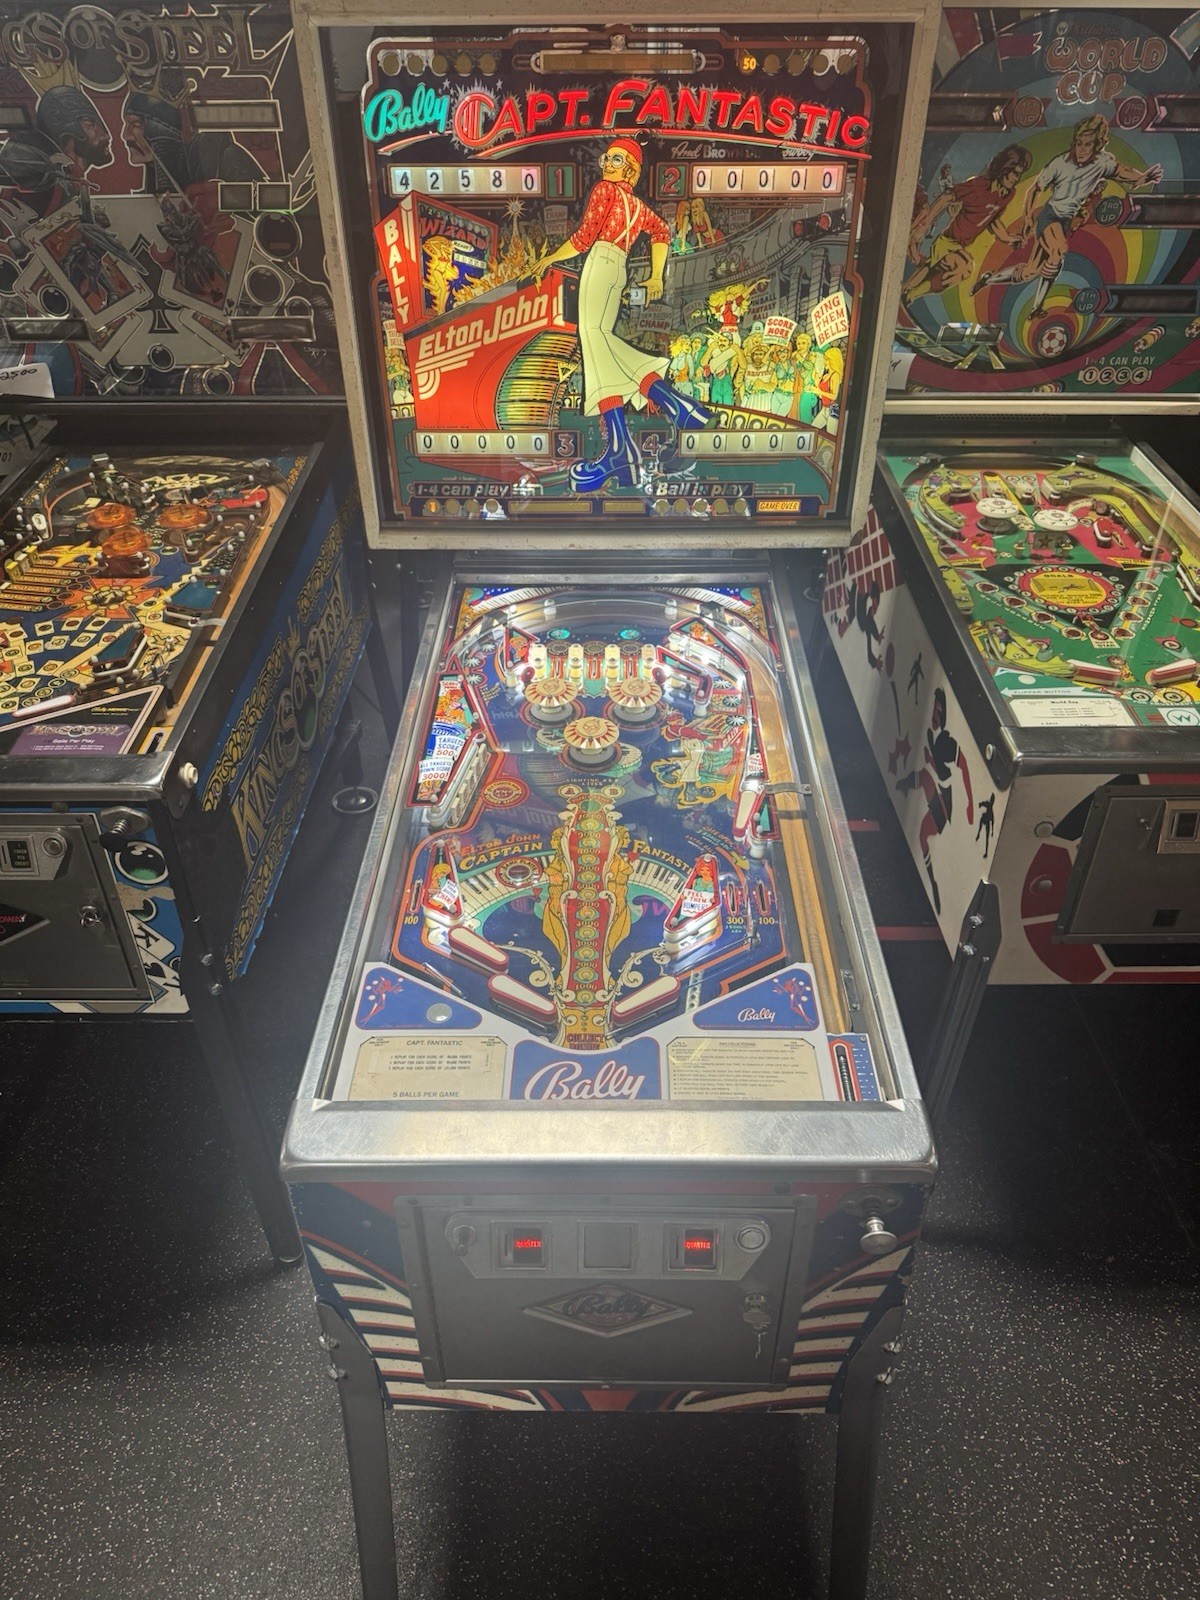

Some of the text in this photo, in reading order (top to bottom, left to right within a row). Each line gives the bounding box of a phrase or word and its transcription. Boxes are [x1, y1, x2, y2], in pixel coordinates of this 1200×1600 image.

[1045, 36, 1168, 73] WORLD
[743, 56, 757, 71] 50
[1056, 70, 1126, 105] CUP
[364, 79, 871, 148] Bally CAPT. FANTASTIC
[1124, 116, 1140, 125] UP
[554, 168, 564, 195] 1
[661, 167, 681, 195] 2
[1101, 214, 1116, 223] UP
[383, 219, 410, 325] BALLY
[814, 295, 842, 321] RING
[1079, 303, 1094, 312] UP
[484, 293, 549, 346] John
[768, 318, 794, 330] SCORE
[815, 308, 846, 333] THEM
[768, 327, 790, 339] MORE
[817, 319, 849, 346] BELLS
[1110, 357, 1128, 366] CAN
[1132, 356, 1155, 366] PLAY
[557, 433, 575, 457] 3
[417, 483, 511, 498] 1-4 can play
[656, 482, 690, 496] Ball
[711, 483, 750, 498] play
[759, 502, 799, 512] GAME OVER
[437, 743, 459, 752] SCORE
[422, 772, 449, 781] 3000!
[506, 832, 541, 844] JOHN
[460, 842, 543, 871] CAPTAIN
[633, 839, 694, 875] FANTASTI
[404, 916, 419, 925] 100
[726, 916, 744, 925] 300
[758, 916, 774, 925] 100
[738, 1007, 777, 1023] Bally
[524, 1060, 646, 1100] Bally
